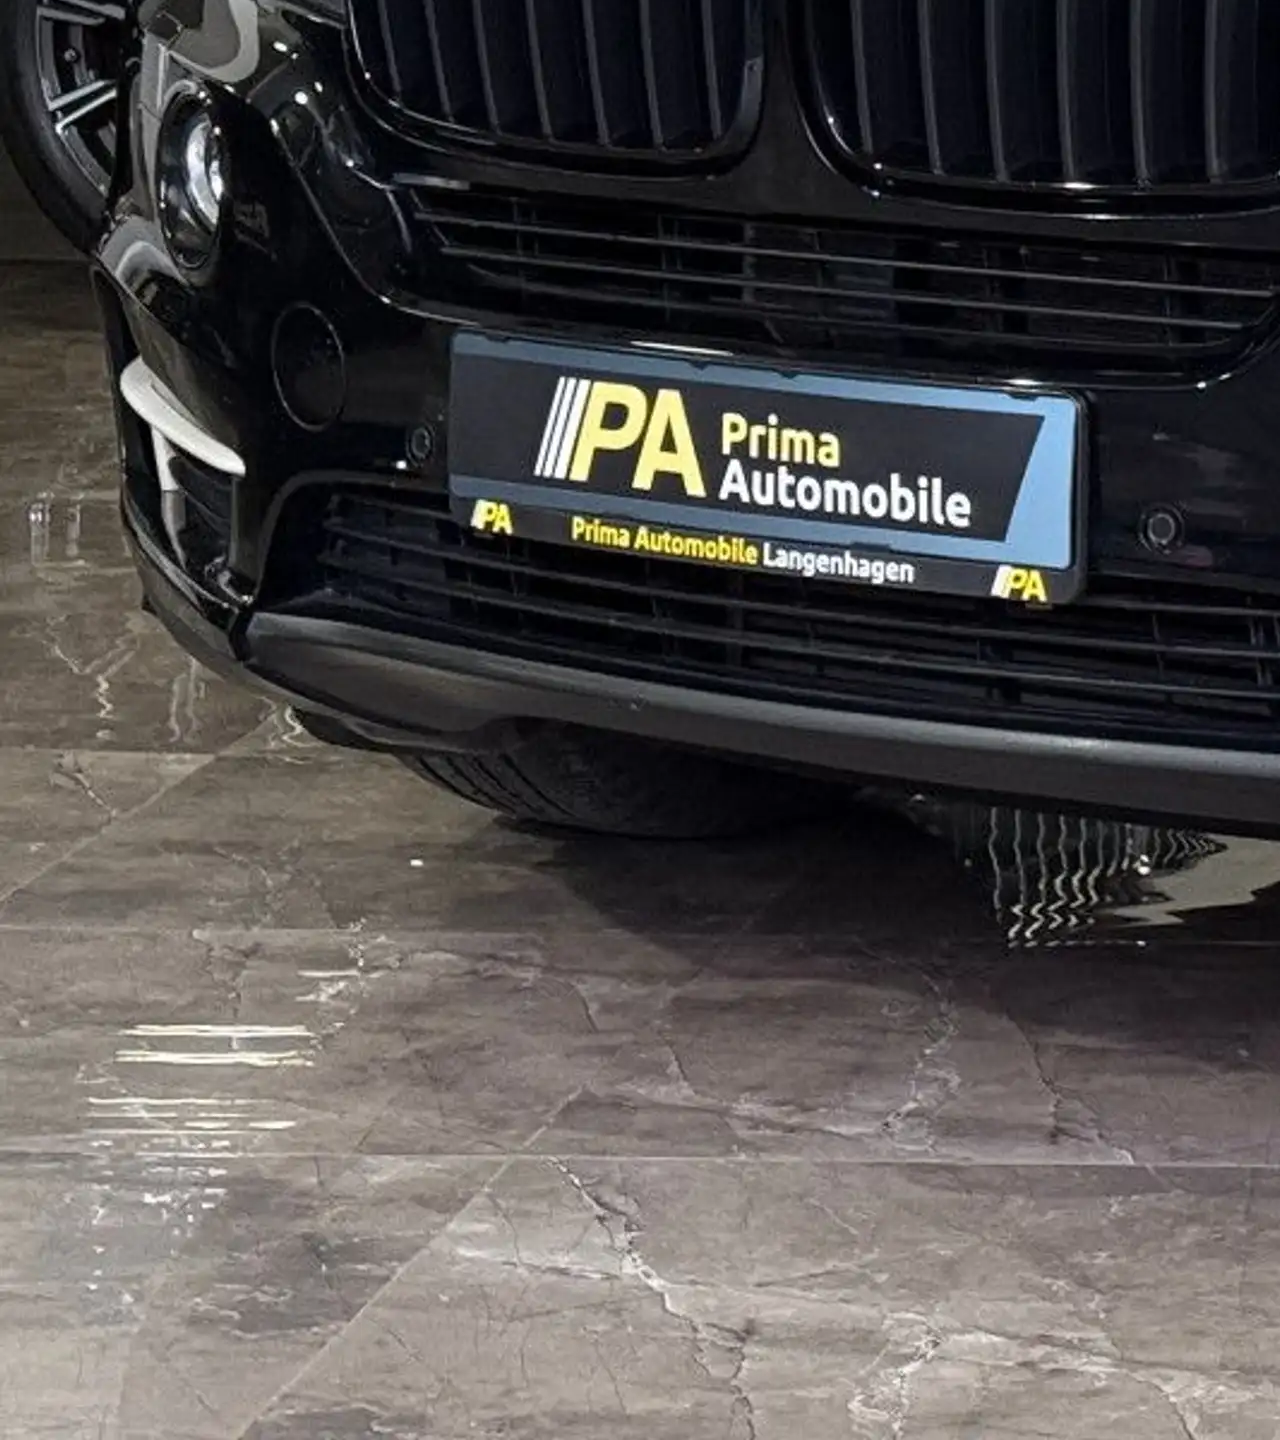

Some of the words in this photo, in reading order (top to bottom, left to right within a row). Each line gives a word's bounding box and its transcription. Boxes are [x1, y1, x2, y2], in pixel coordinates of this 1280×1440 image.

[568, 380, 707, 498] PA
[721, 412, 840, 468] Prima
[718, 458, 972, 528] Automobile
[571, 515, 631, 549] Prima
[633, 525, 758, 566] Automobile
[762, 541, 916, 585] Langenhagen
